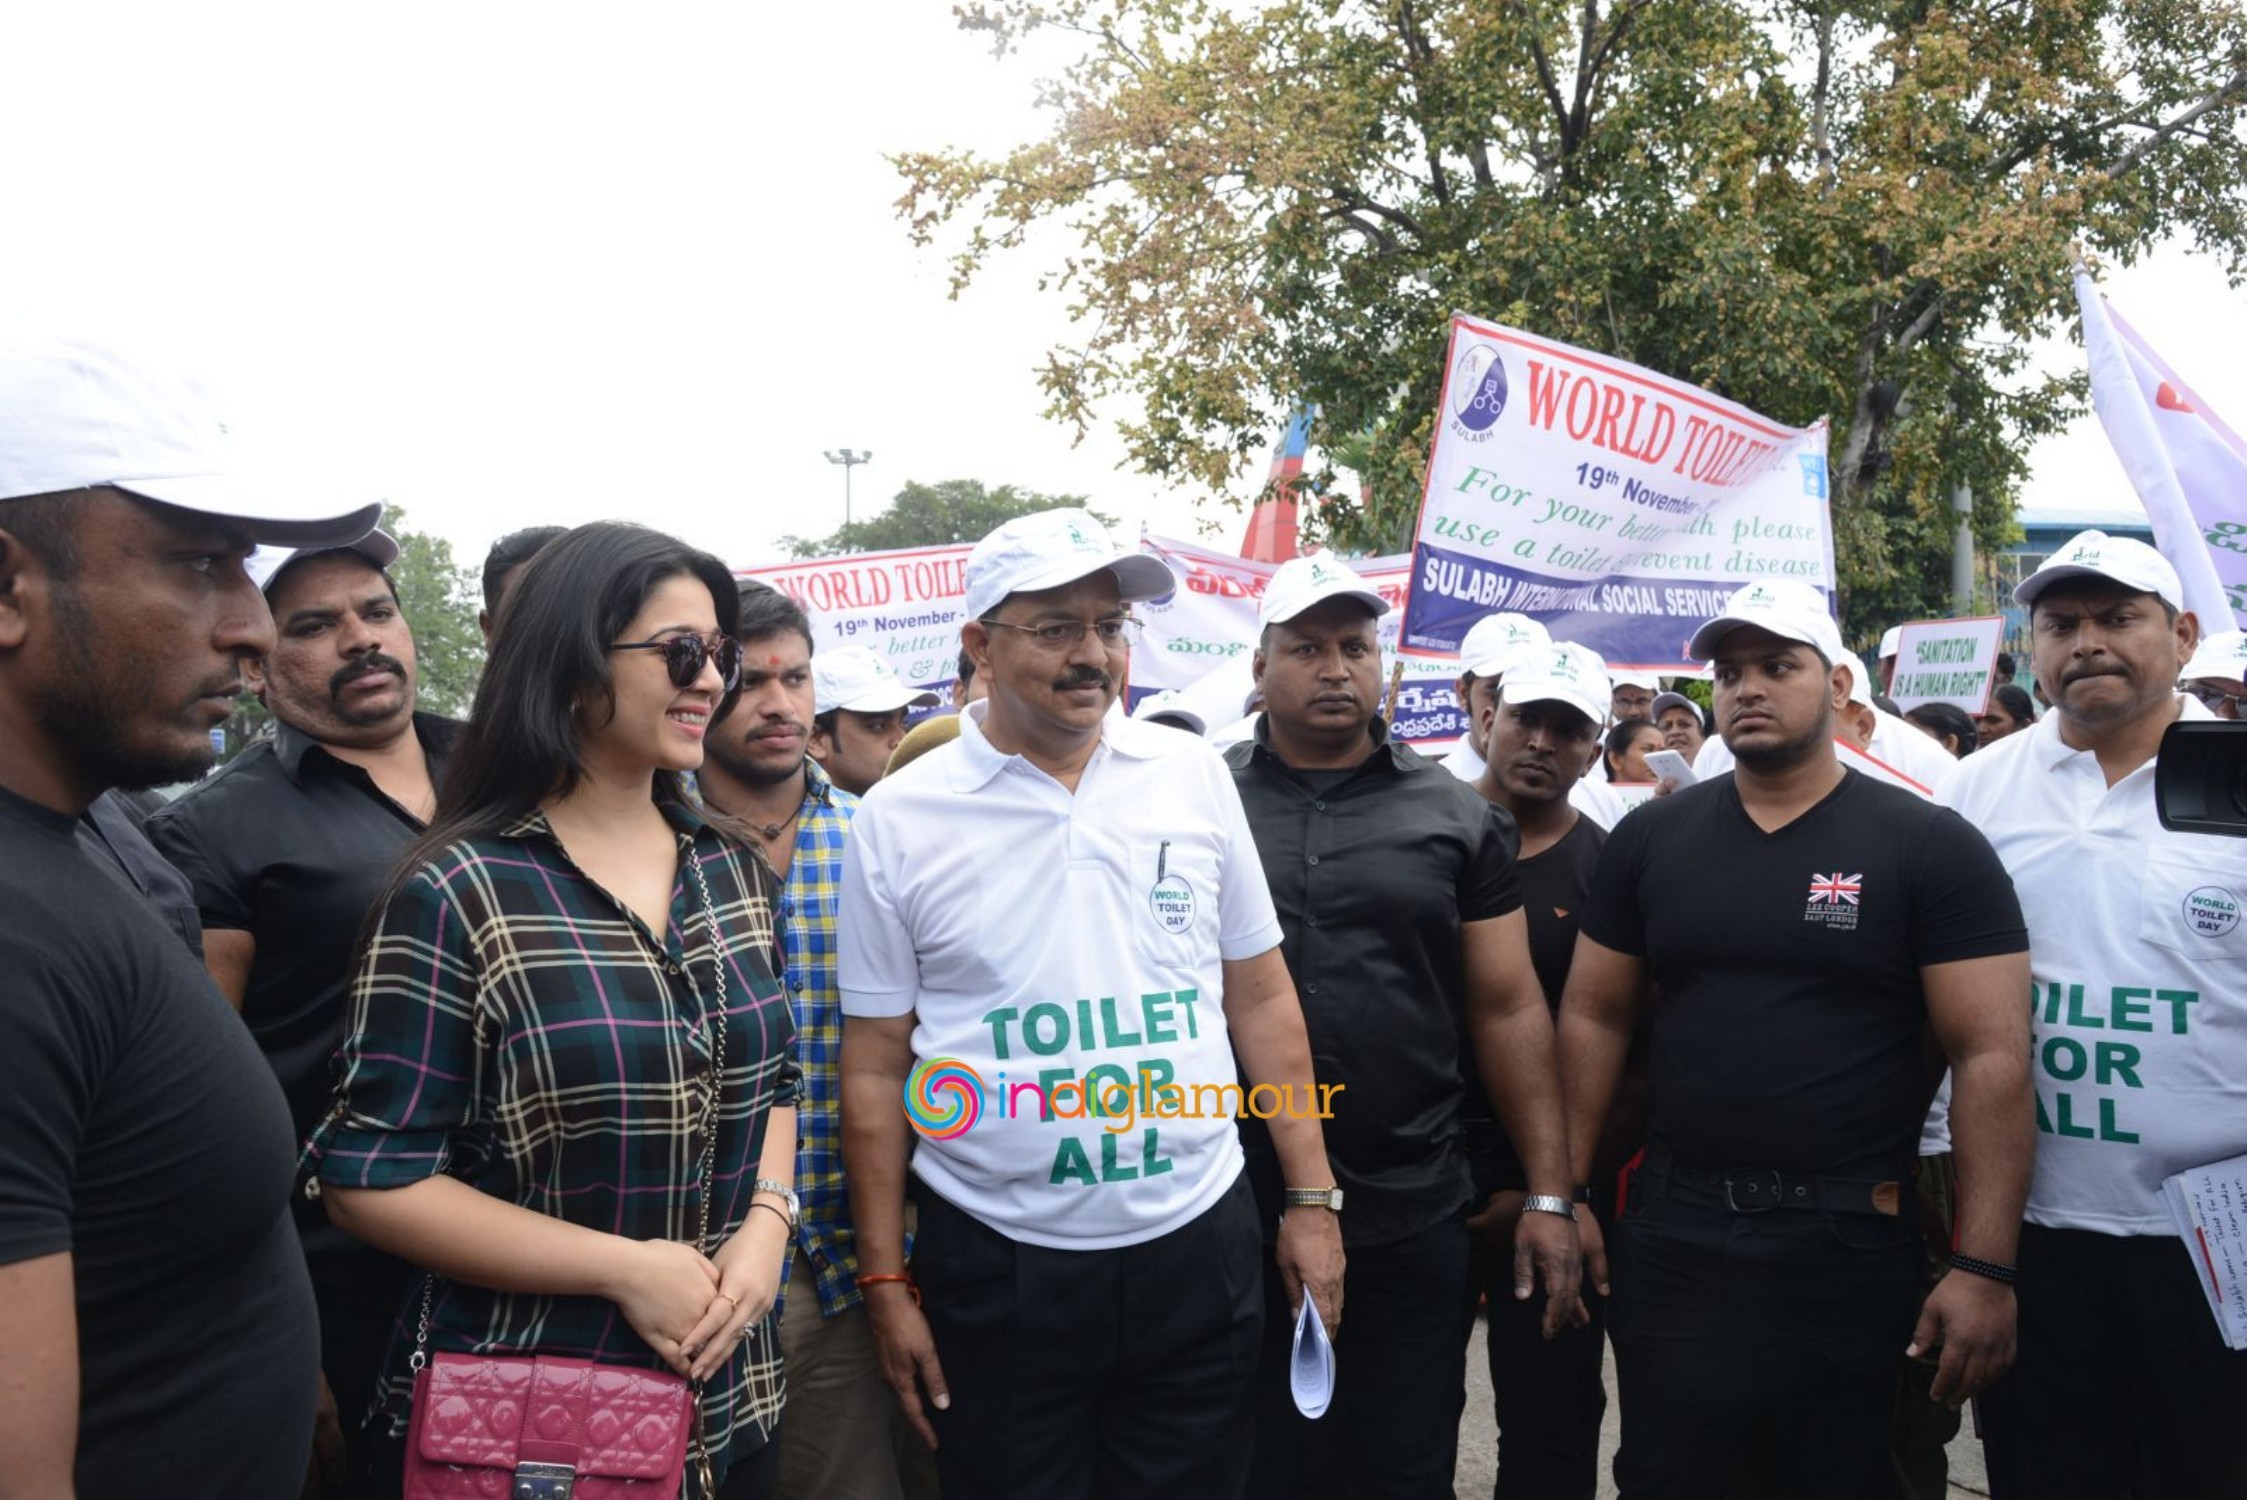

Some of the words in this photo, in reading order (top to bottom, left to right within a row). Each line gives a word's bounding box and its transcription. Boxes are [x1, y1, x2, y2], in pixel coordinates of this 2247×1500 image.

[1527, 359, 1676, 465] WORLD
[1451, 420, 1494, 443] SULABH
[1576, 462, 1619, 490] 19th
[1453, 465, 1532, 507] For
[1532, 498, 1613, 531] your
[1732, 516, 1816, 544] please
[1433, 516, 1499, 547] use
[1514, 538, 1537, 559] a
[1546, 543, 1611, 573] toilet
[1725, 549, 1821, 576] disease
[774, 567, 891, 615] WORLD
[895, 558, 968, 602] TOILE
[1423, 557, 1512, 608] SULABH
[1601, 583, 1663, 615] SOCIAL
[834, 618, 868, 637] 19th
[874, 609, 957, 633] November
[888, 635, 948, 656] better
[909, 659, 933, 679] &
[1912, 672, 1950, 697] HUMAN
[1154, 891, 1189, 901] WORLD
[1157, 903, 1191, 913] TOILET
[1806, 903, 1823, 912] LEE
[1824, 903, 1859, 913] COOPER
[2191, 895, 2235, 911] WORLD
[1166, 916, 1186, 926] DAY
[1826, 914, 1858, 925] LONDON
[2190, 907, 2235, 922] TOILET
[2197, 920, 2222, 932] DAY
[2032, 982, 2200, 1035] ILET
[982, 988, 1200, 1061] TOILET
[1038, 1058, 1179, 1123] FOR
[1049, 1127, 1174, 1187] ALL
